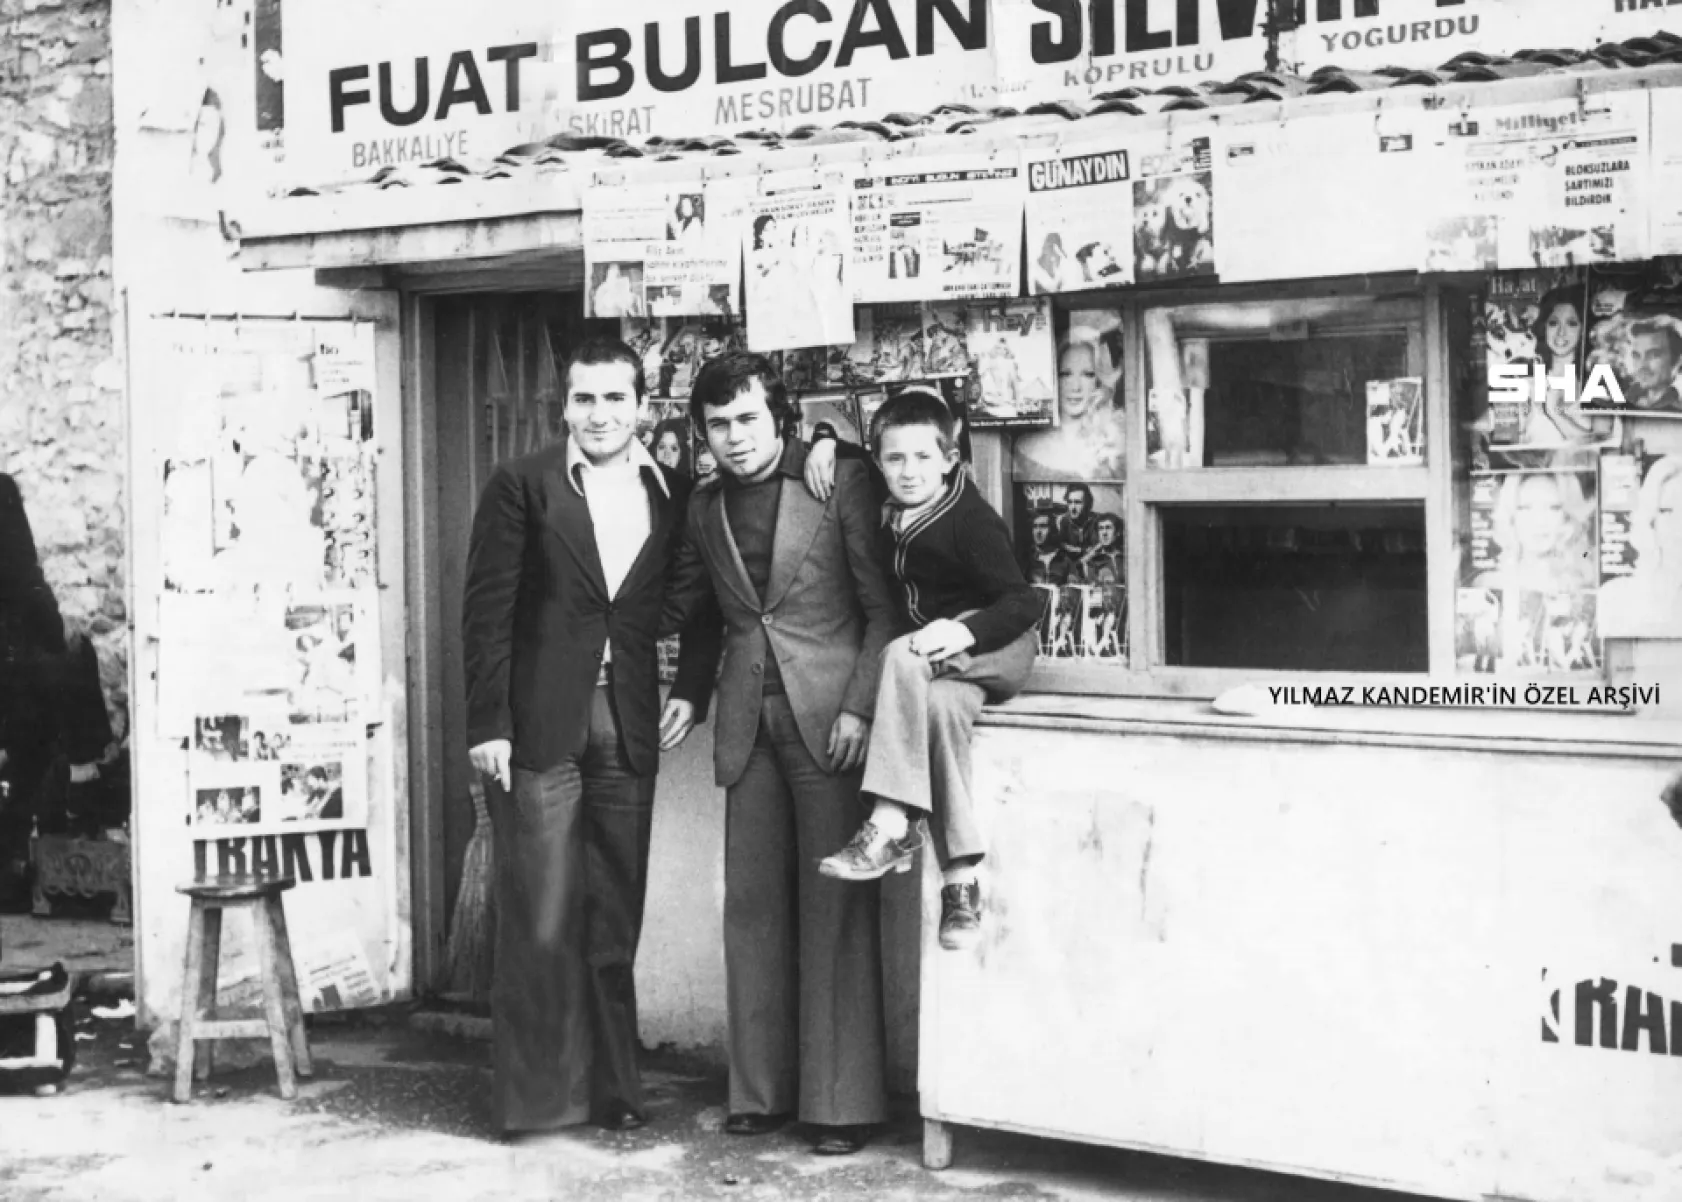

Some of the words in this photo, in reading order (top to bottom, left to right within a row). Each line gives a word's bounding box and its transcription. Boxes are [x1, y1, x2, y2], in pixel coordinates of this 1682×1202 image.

[1321, 14, 1480, 53] YOGURDU
[328, 41, 538, 133] FUAT
[575, 0, 988, 102] BULCAN
[714, 76, 873, 126] MESRUBAT
